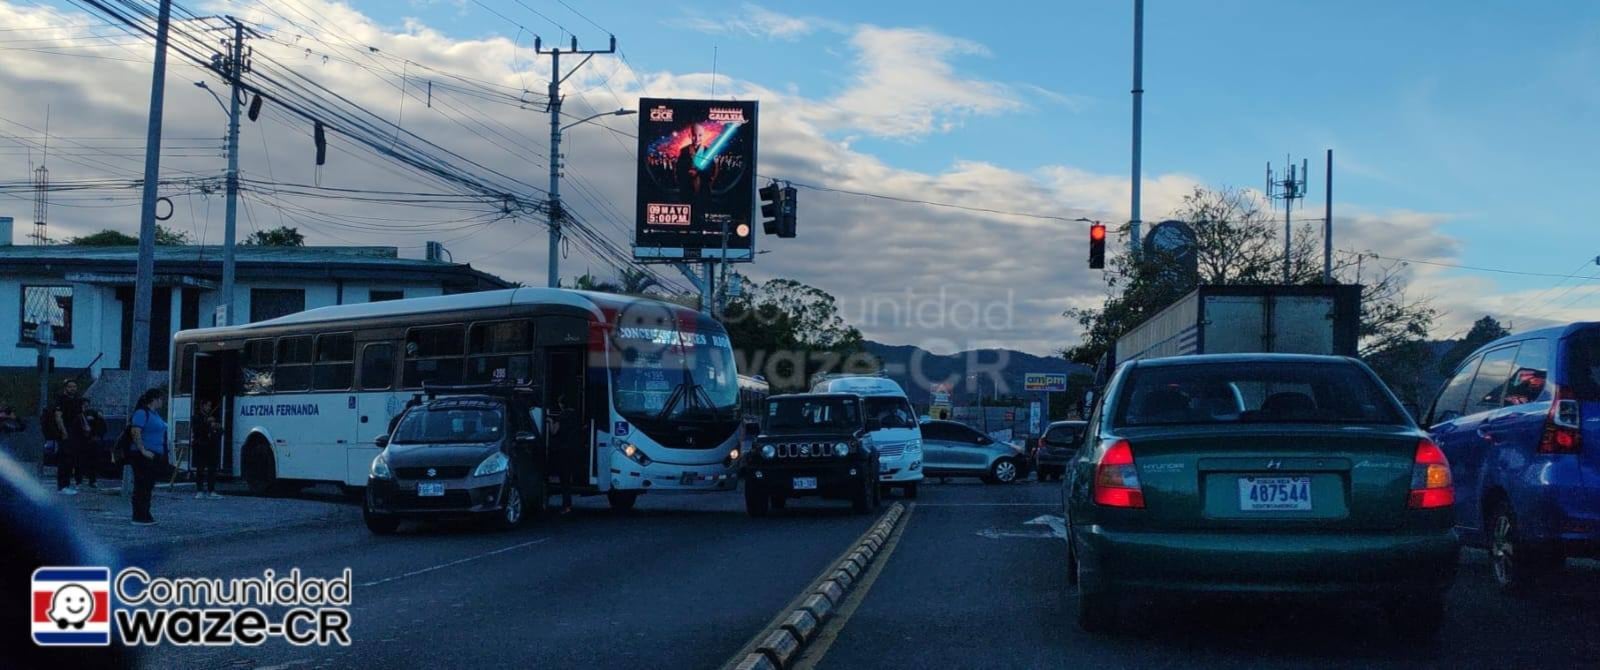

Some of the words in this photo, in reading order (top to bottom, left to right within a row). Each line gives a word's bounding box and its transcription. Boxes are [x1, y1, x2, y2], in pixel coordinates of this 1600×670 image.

[708, 113, 744, 121] GALAXIA
[649, 206, 661, 214] 09
[662, 207, 689, 215] MAYO
[240, 403, 274, 417] ALEYZHA
[275, 403, 319, 417] FERNANDA
[1249, 484, 1308, 502] 487544
